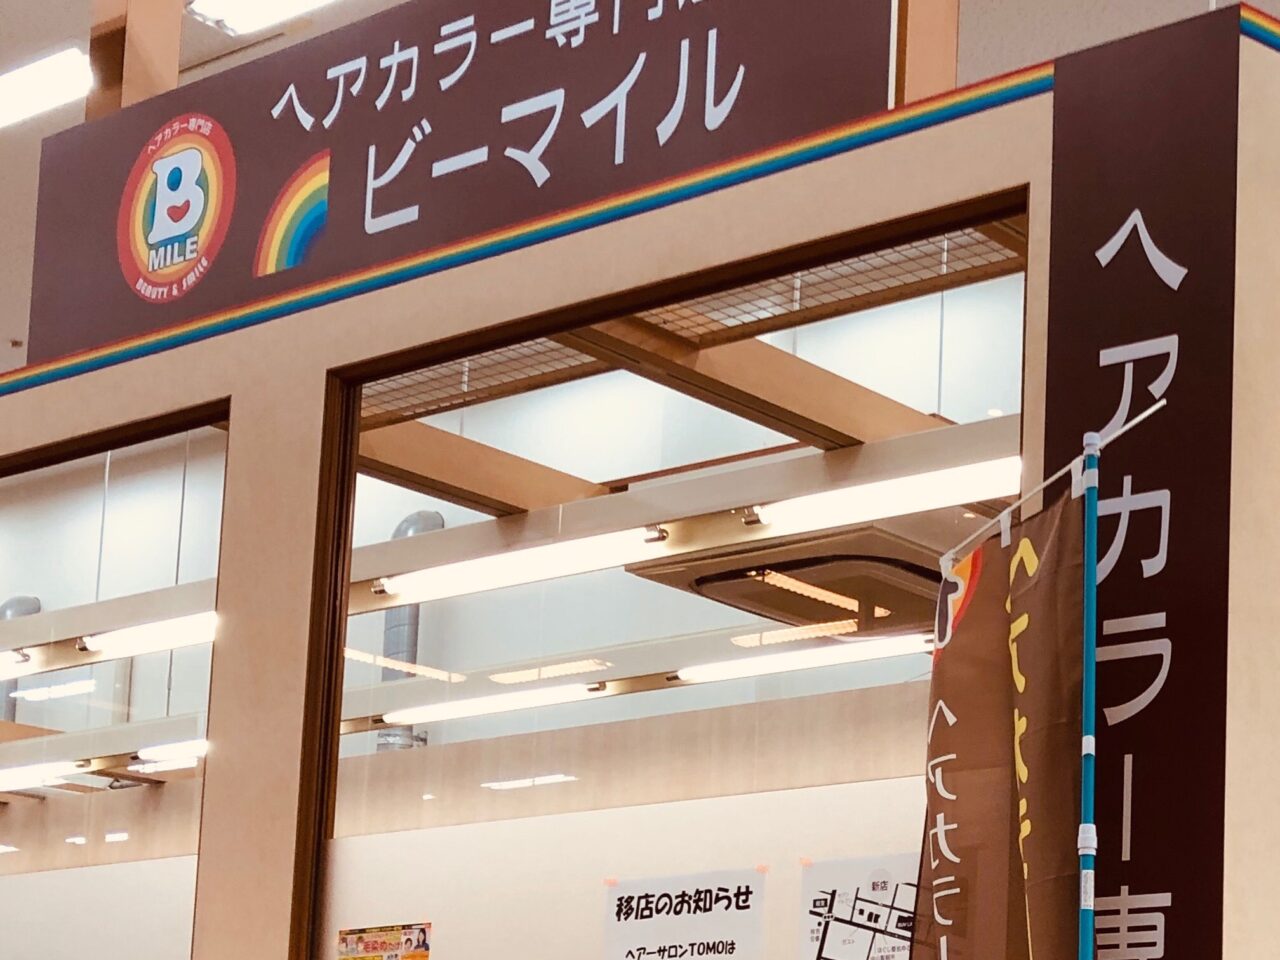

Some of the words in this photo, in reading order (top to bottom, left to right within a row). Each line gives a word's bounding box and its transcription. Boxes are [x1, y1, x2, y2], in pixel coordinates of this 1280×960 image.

[271, 0, 698, 131] ヘアカラー専
[148, 117, 213, 154] ヘアカラー専門店
[365, 28, 745, 235] ビーマイル
[149, 236, 200, 272] MILE
[616, 885, 753, 922] 移店のお知らせ
[871, 881, 888, 892] 新店
[625, 940, 736, 960] ヘアーサロンTOMOは
